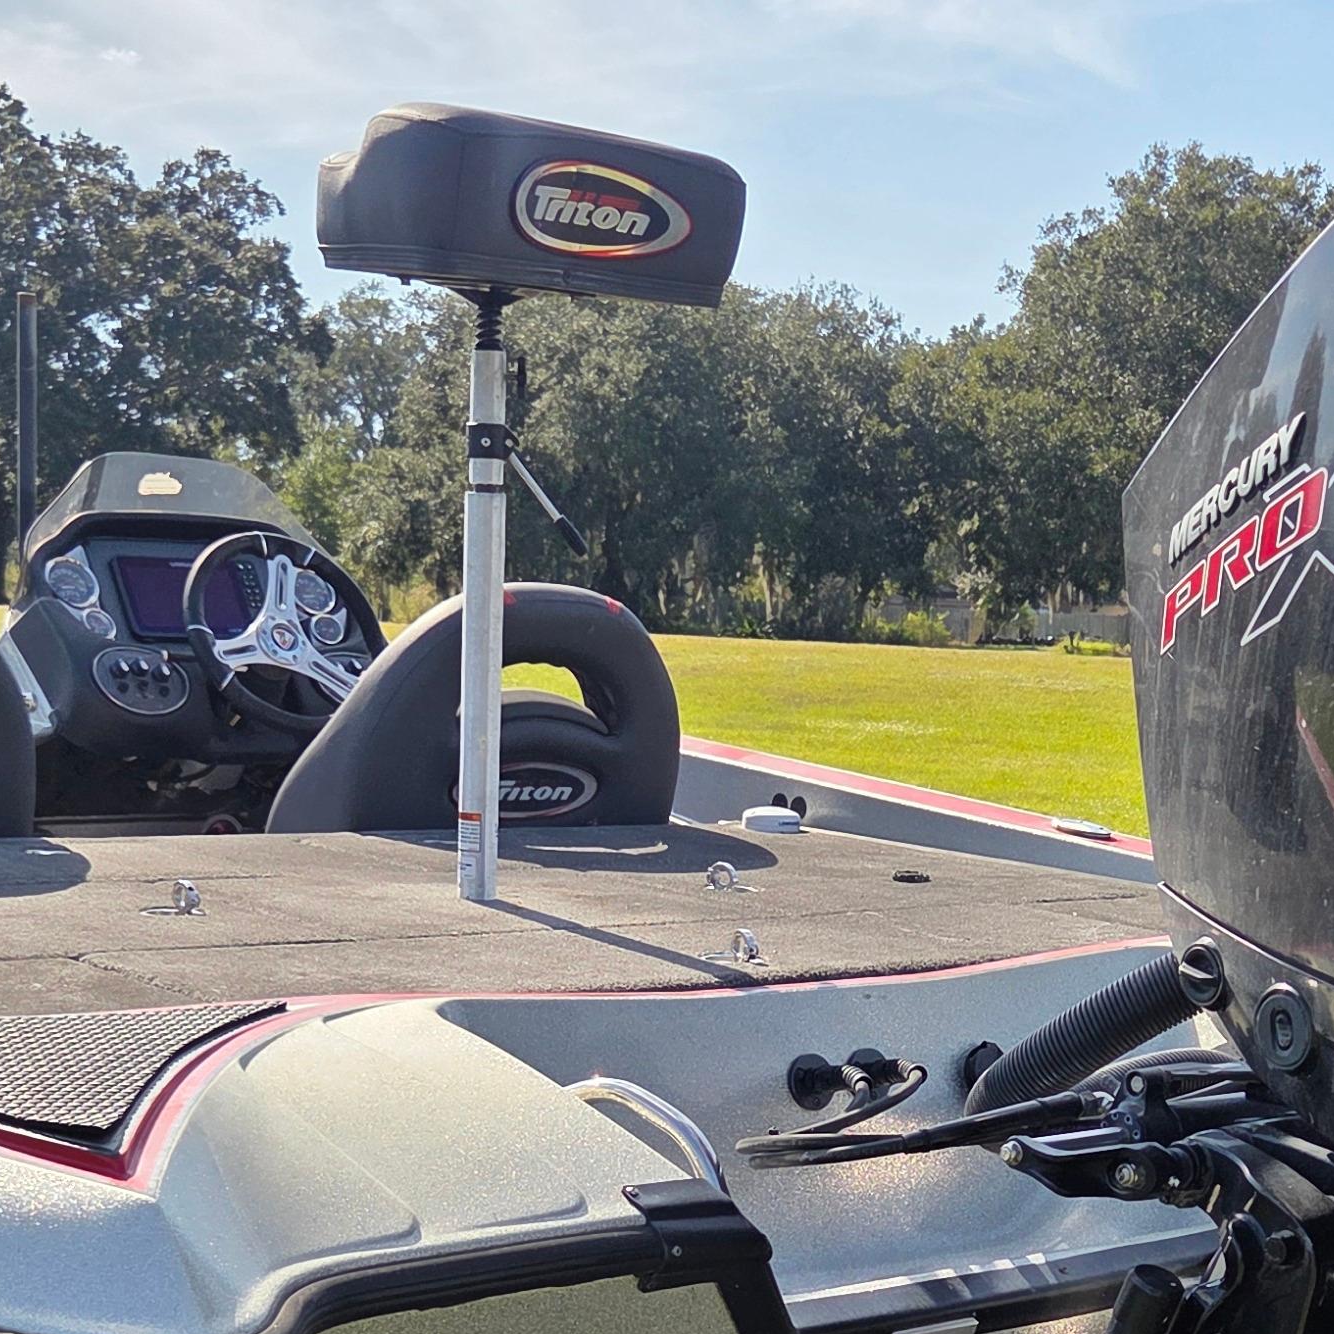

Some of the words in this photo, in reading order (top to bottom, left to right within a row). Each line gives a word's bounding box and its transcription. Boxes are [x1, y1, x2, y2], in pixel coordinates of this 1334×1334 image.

[533, 185, 651, 236] Triton
[1160, 467, 1328, 656] PRO
[1168, 411, 1307, 566] MERCURY
